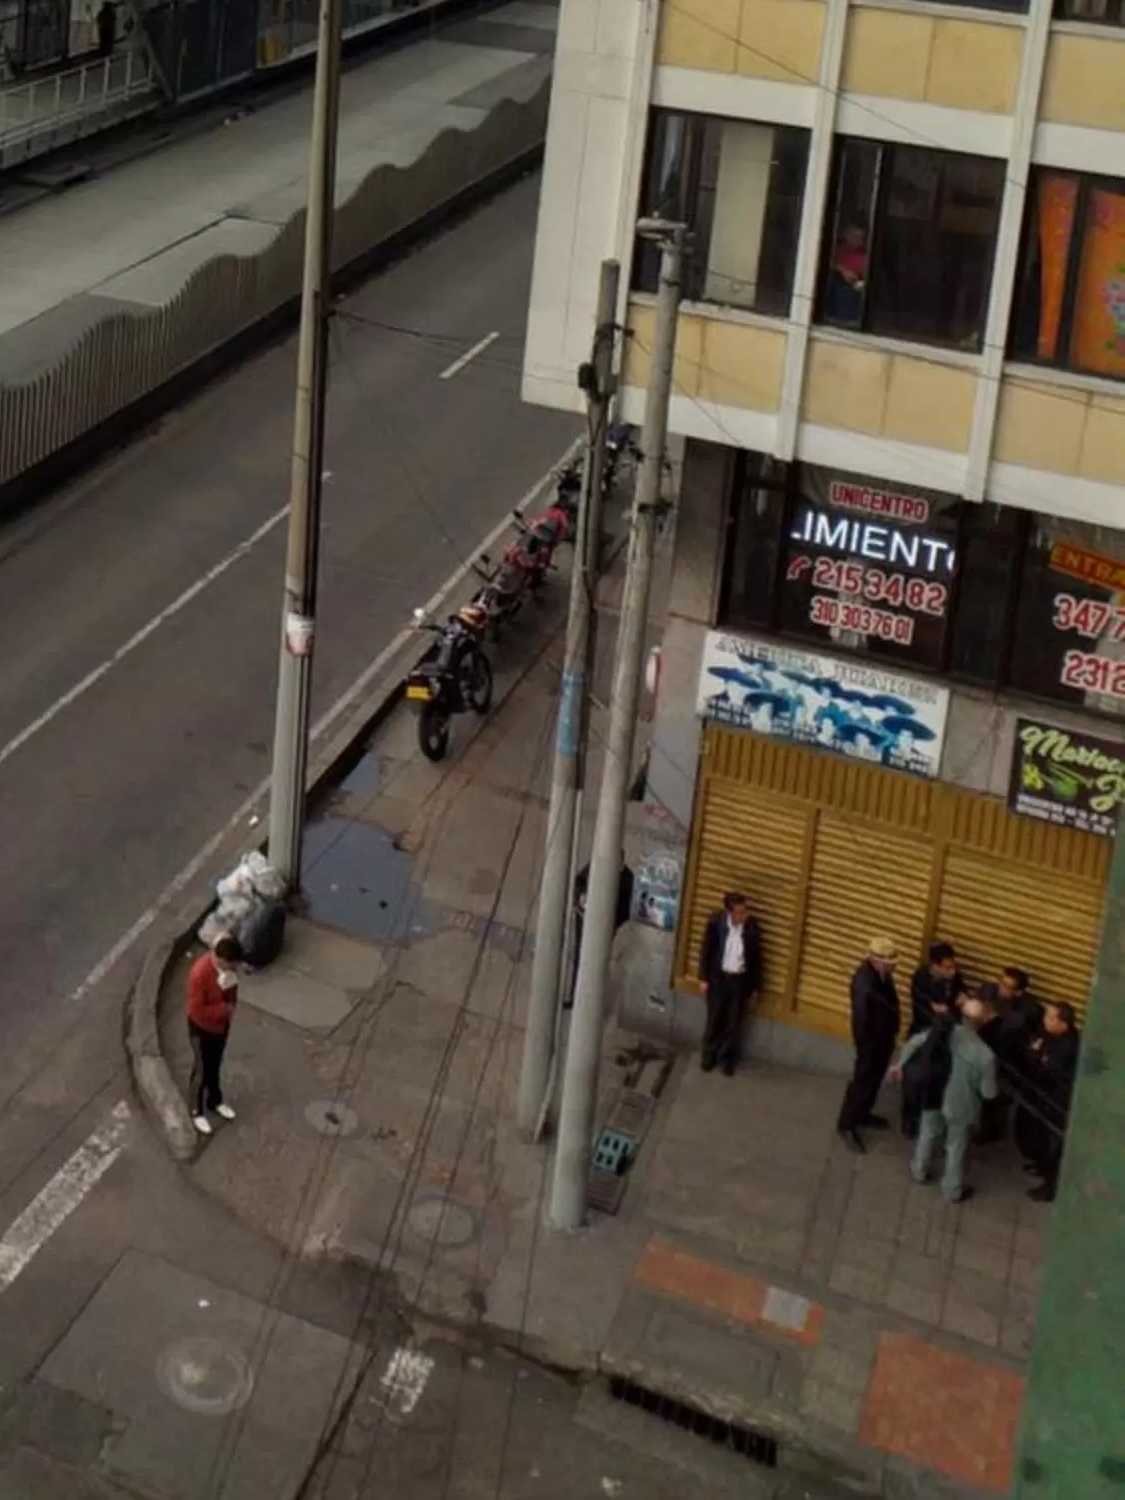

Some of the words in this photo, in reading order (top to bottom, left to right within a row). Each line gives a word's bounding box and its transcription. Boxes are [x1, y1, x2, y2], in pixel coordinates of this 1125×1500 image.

[831, 483, 928, 522] UNICENTRO
[813, 557, 863, 594] 215
[864, 569, 904, 605] 34
[906, 578, 947, 616] 82
[1053, 593, 1111, 639] 347
